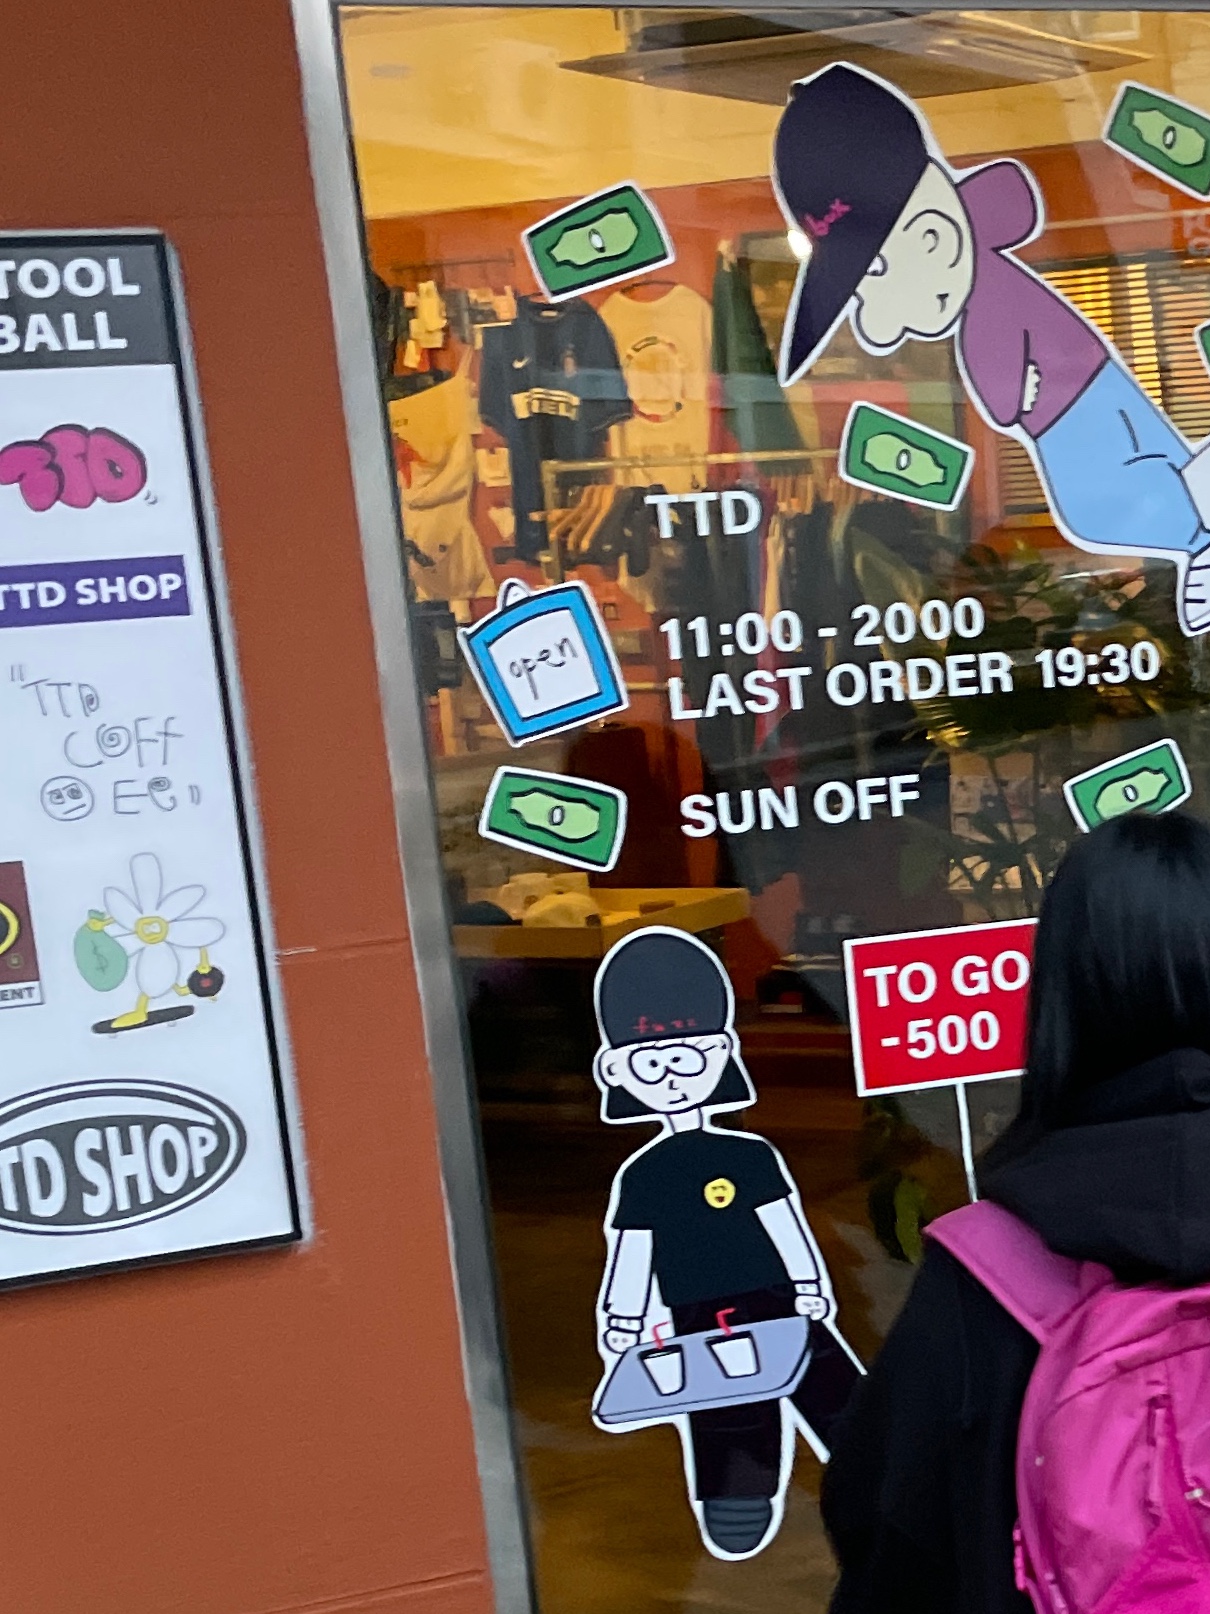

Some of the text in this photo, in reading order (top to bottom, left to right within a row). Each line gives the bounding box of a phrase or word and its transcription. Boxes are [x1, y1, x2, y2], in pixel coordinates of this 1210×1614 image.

[0, 311, 128, 354] BALL
[645, 490, 762, 540] TTD
[0, 573, 182, 611] TTD SHOP
[659, 609, 804, 660] 11:00
[508, 634, 579, 700] open
[668, 641, 1161, 721] LAST ORDER 19:30
[680, 774, 920, 838] SUN OFF
[862, 950, 1031, 1008] TO GO
[880, 1010, 1001, 1059] -500
[74, 1123, 218, 1217] SHOP
